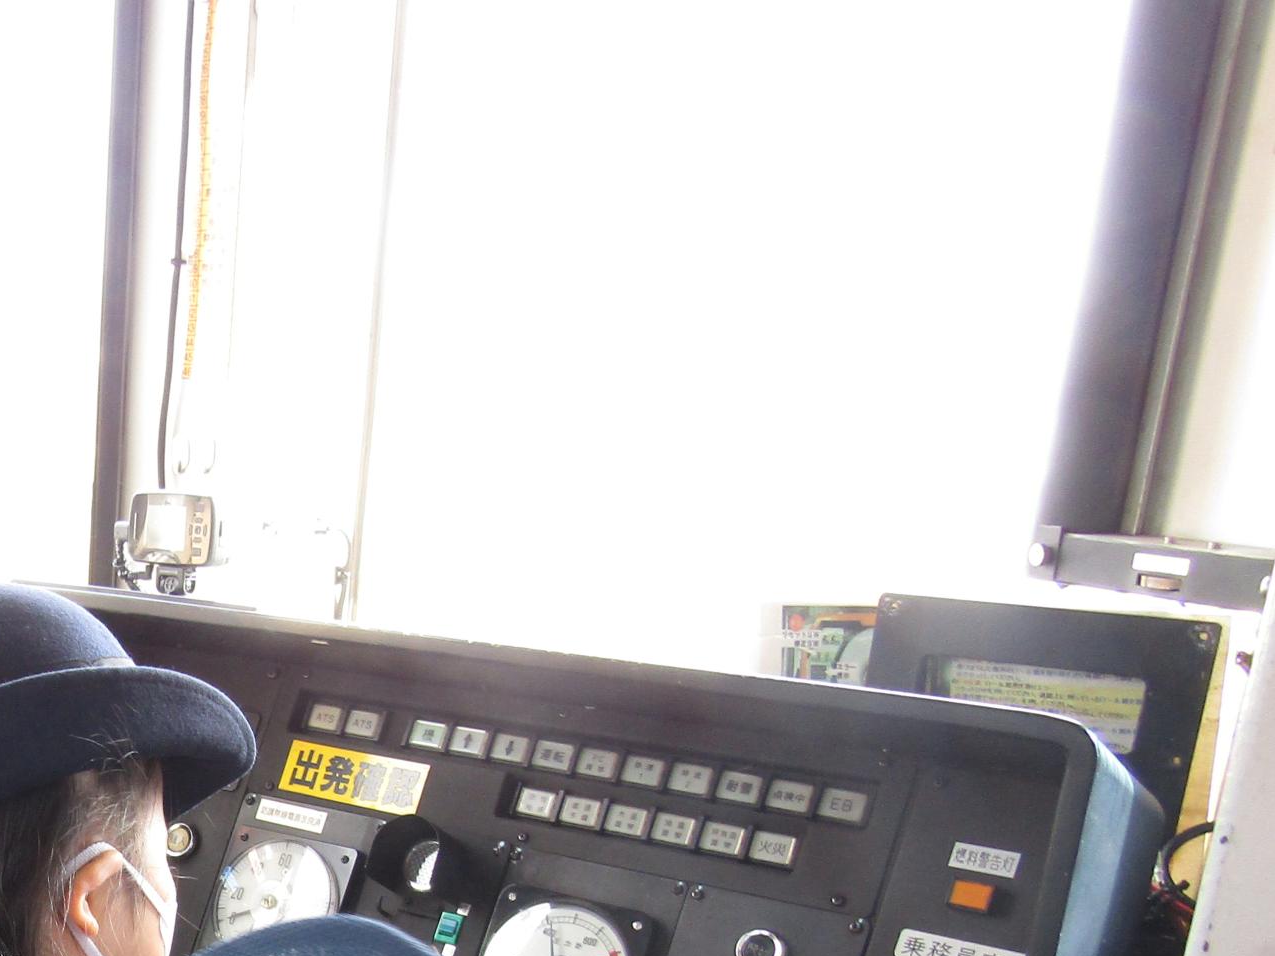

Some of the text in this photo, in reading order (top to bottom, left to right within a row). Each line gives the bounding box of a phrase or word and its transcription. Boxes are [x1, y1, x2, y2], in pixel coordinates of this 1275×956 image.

[315, 711, 335, 724] ATS
[352, 717, 374, 730] ATS
[288, 749, 422, 809] 出発確認
[278, 852, 293, 870] 60
[954, 847, 1016, 873] 燃料警告灯
[230, 886, 245, 901] 20
